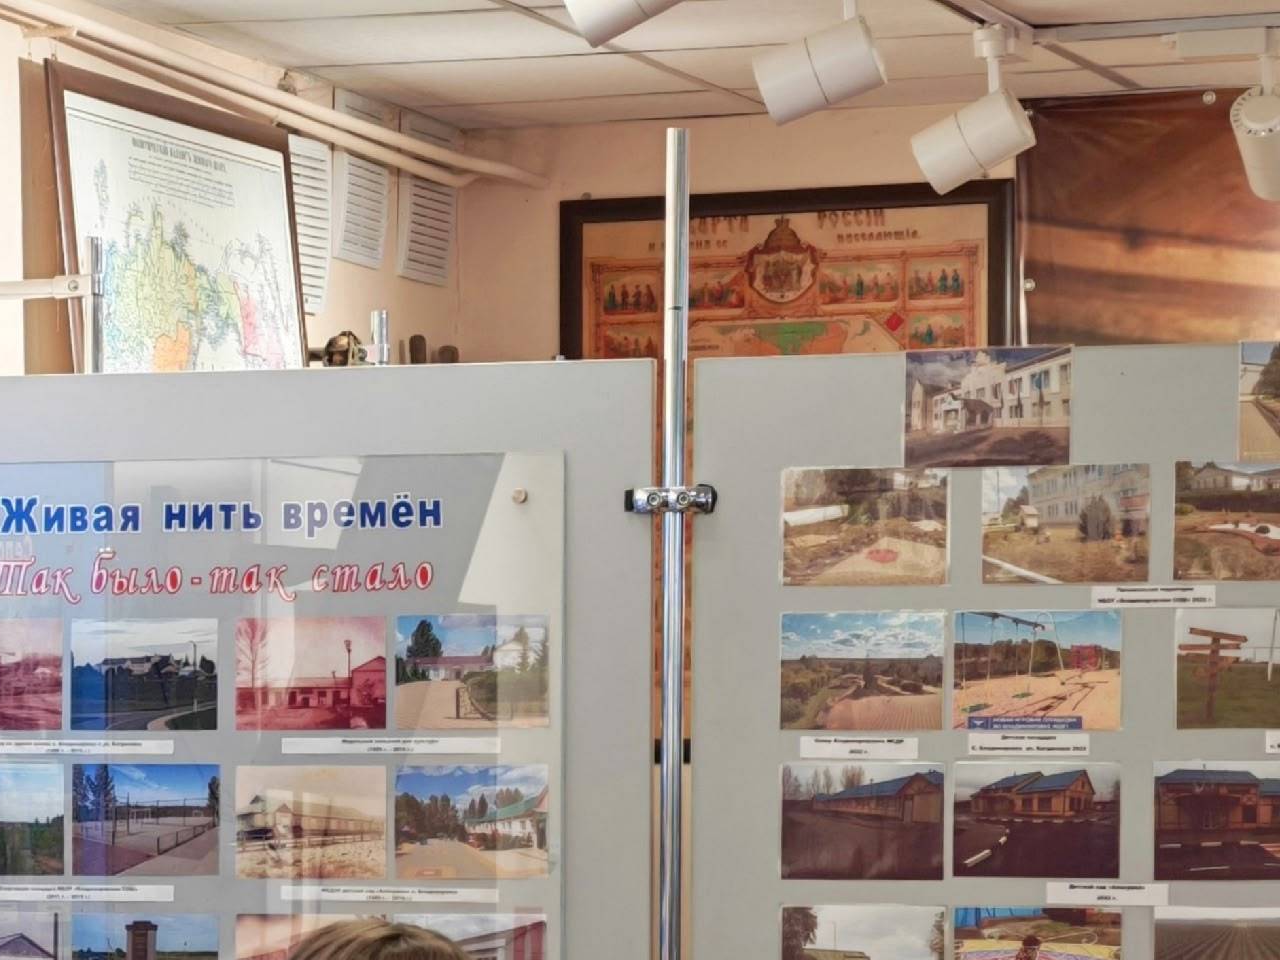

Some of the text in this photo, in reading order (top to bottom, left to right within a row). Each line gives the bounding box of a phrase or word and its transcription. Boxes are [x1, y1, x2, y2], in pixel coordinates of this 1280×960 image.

[162, 500, 264, 533] нить
[282, 492, 443, 539] времён
[310, 559, 435, 595] стало
